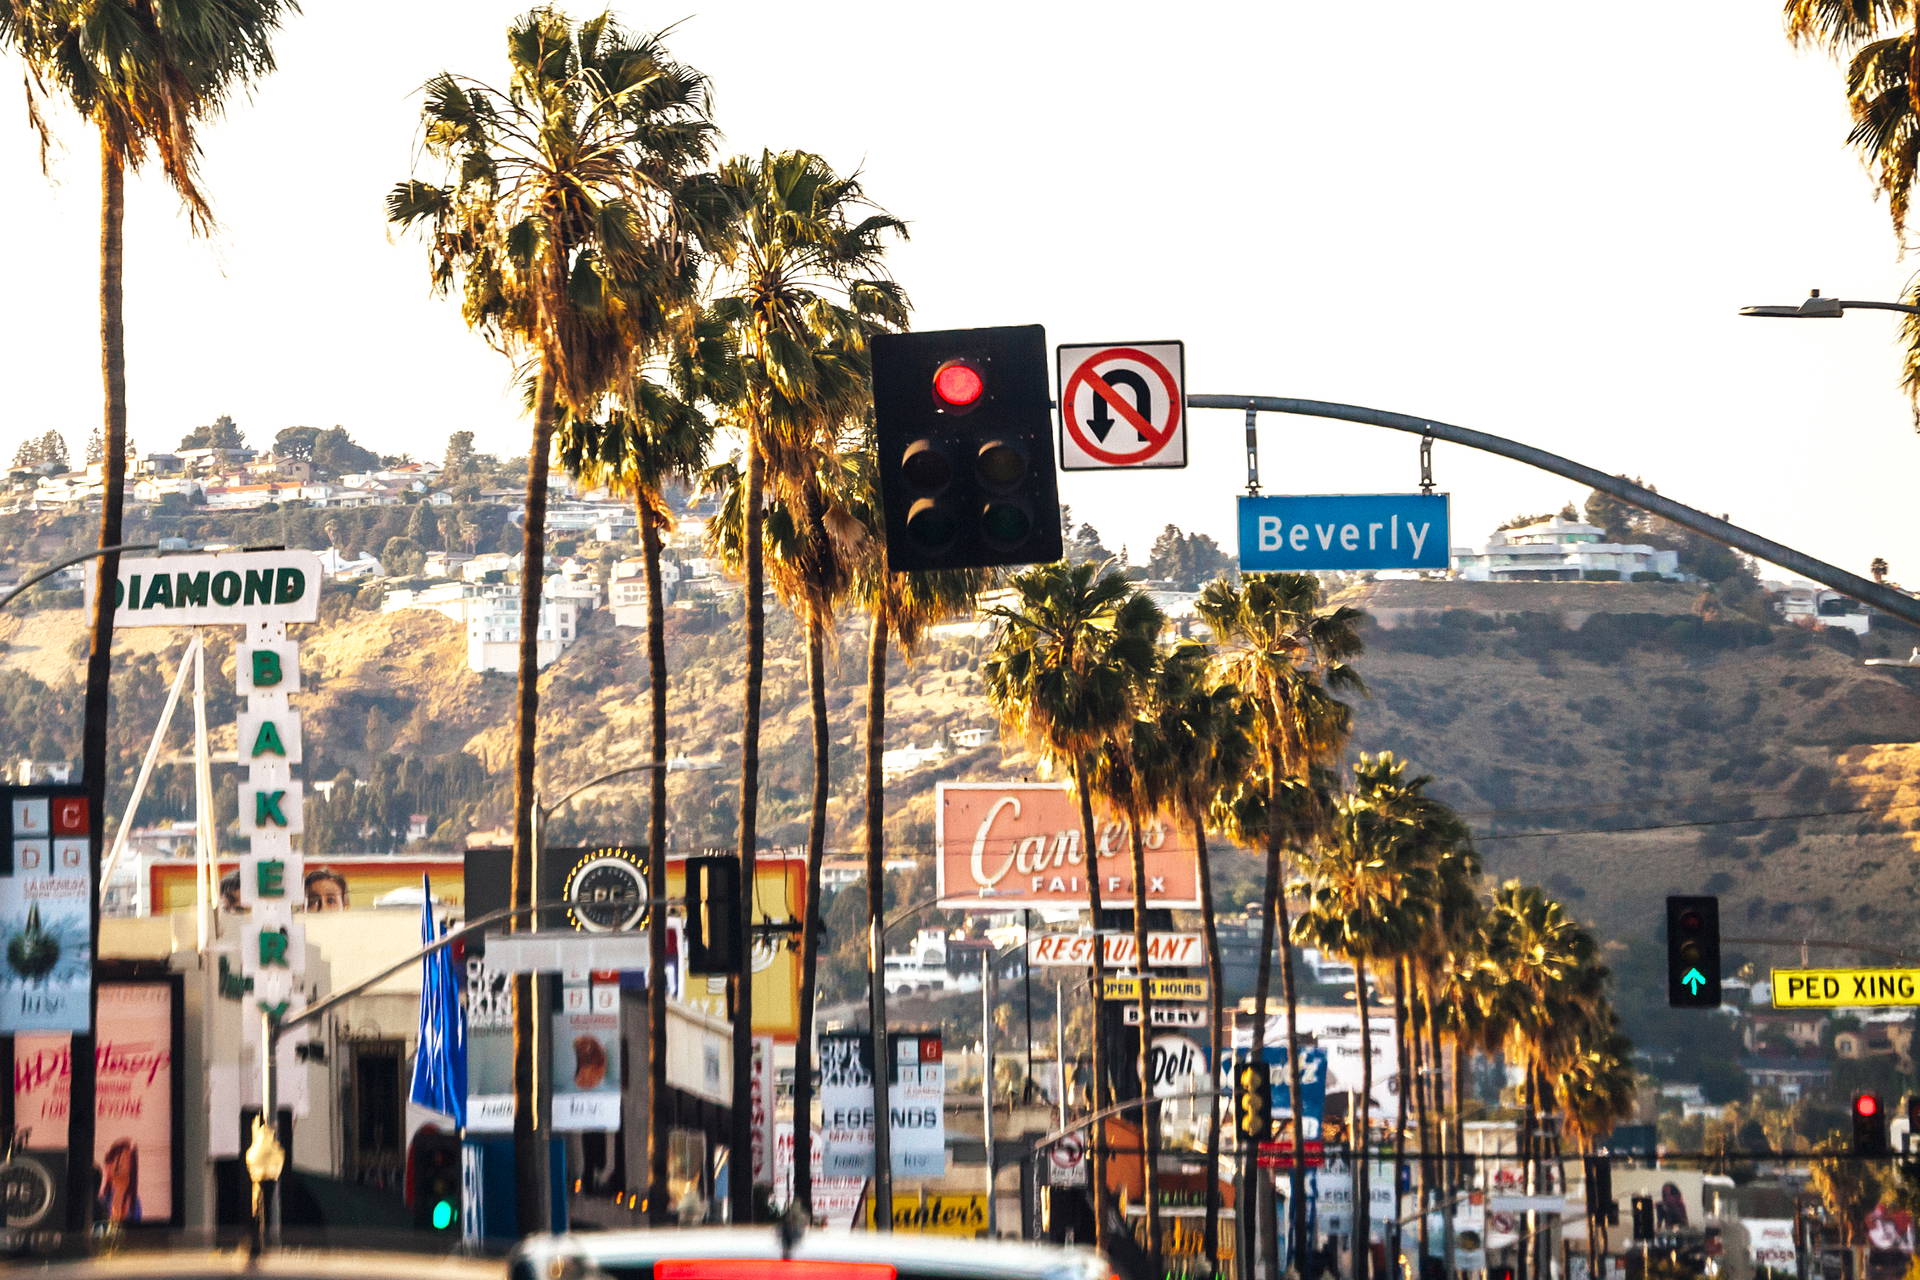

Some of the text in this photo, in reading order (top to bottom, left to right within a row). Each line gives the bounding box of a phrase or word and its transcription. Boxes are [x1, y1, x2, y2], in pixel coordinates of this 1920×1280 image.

[1258, 514, 1431, 560] Beverly
[1031, 876, 1165, 893] FAIFX
[1160, 983, 1202, 996] HOURS
[1788, 976, 1915, 999] PED XING
[1128, 1010, 1200, 1023] BKERY
[1152, 1038, 1195, 1086] Deli
[873, 1194, 984, 1228] anter's
